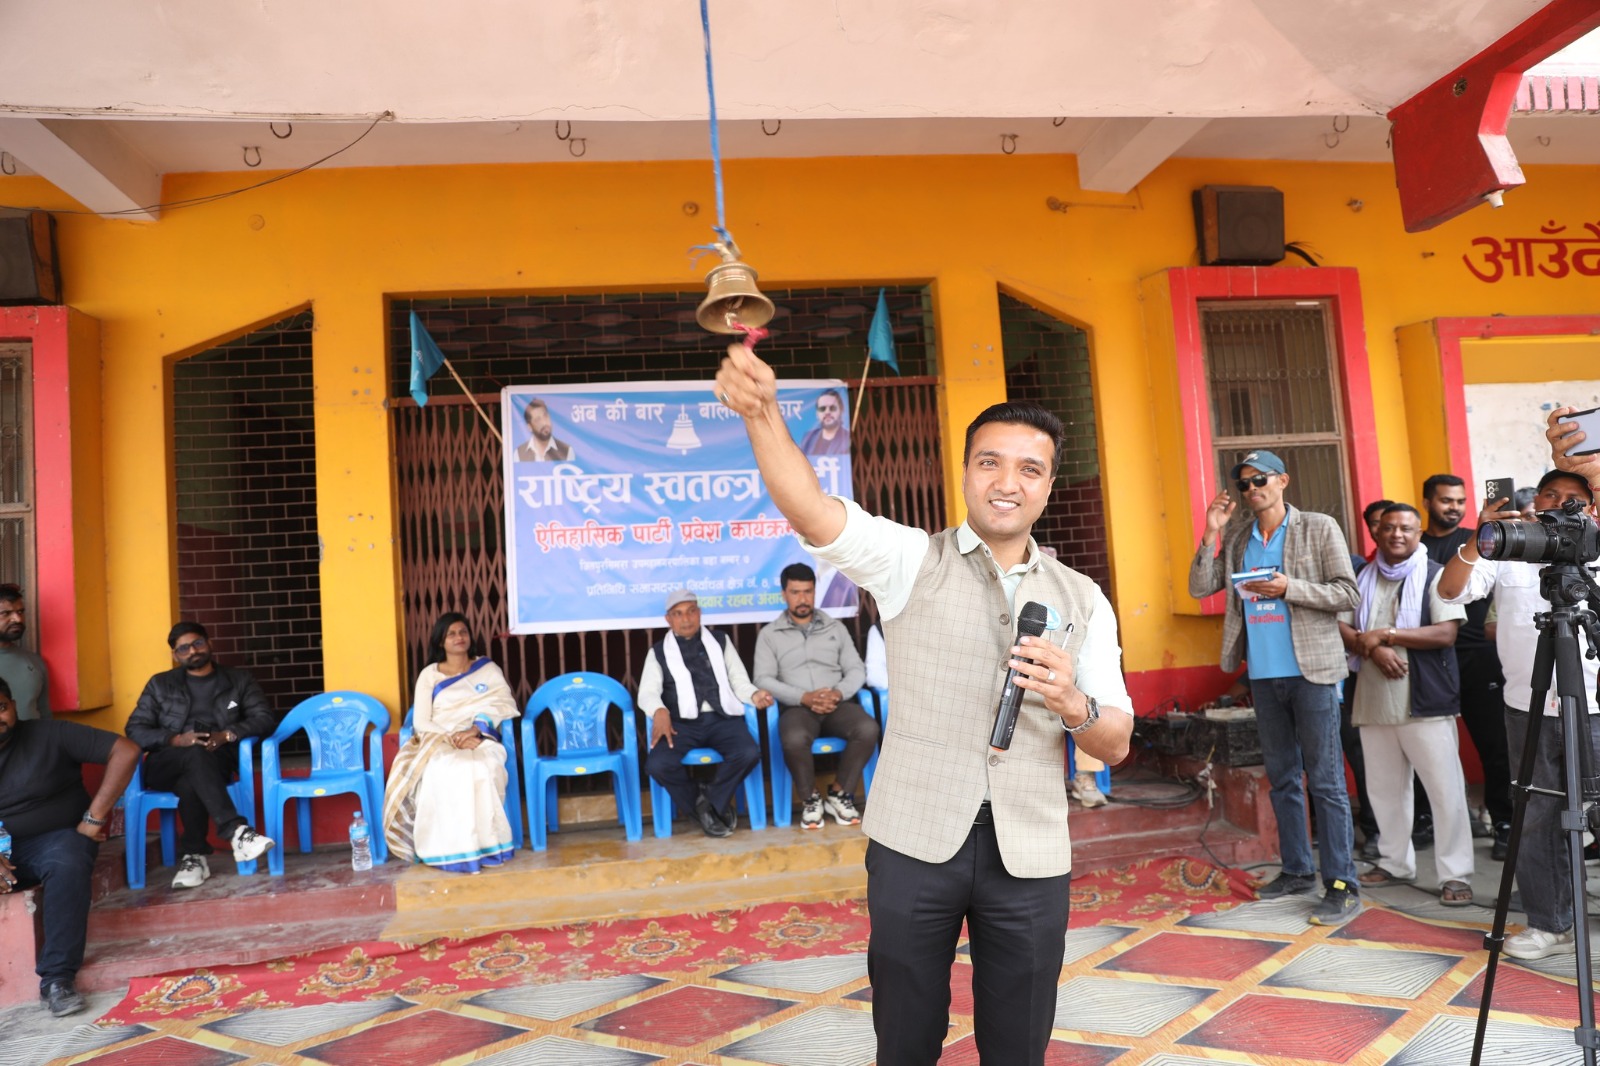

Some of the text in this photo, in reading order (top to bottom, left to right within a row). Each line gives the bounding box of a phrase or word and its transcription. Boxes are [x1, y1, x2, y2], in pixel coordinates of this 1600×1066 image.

[571, 398, 665, 423] अब की बार
[518, 463, 633, 513] राष्ट्रिय
[644, 469, 760, 504] स्वतन्त्र
[535, 519, 626, 552] ऐतिहासिक
[631, 516, 673, 544] पार्टी
[679, 517, 722, 544] प्रवेश
[757, 591, 785, 605] अंसार
